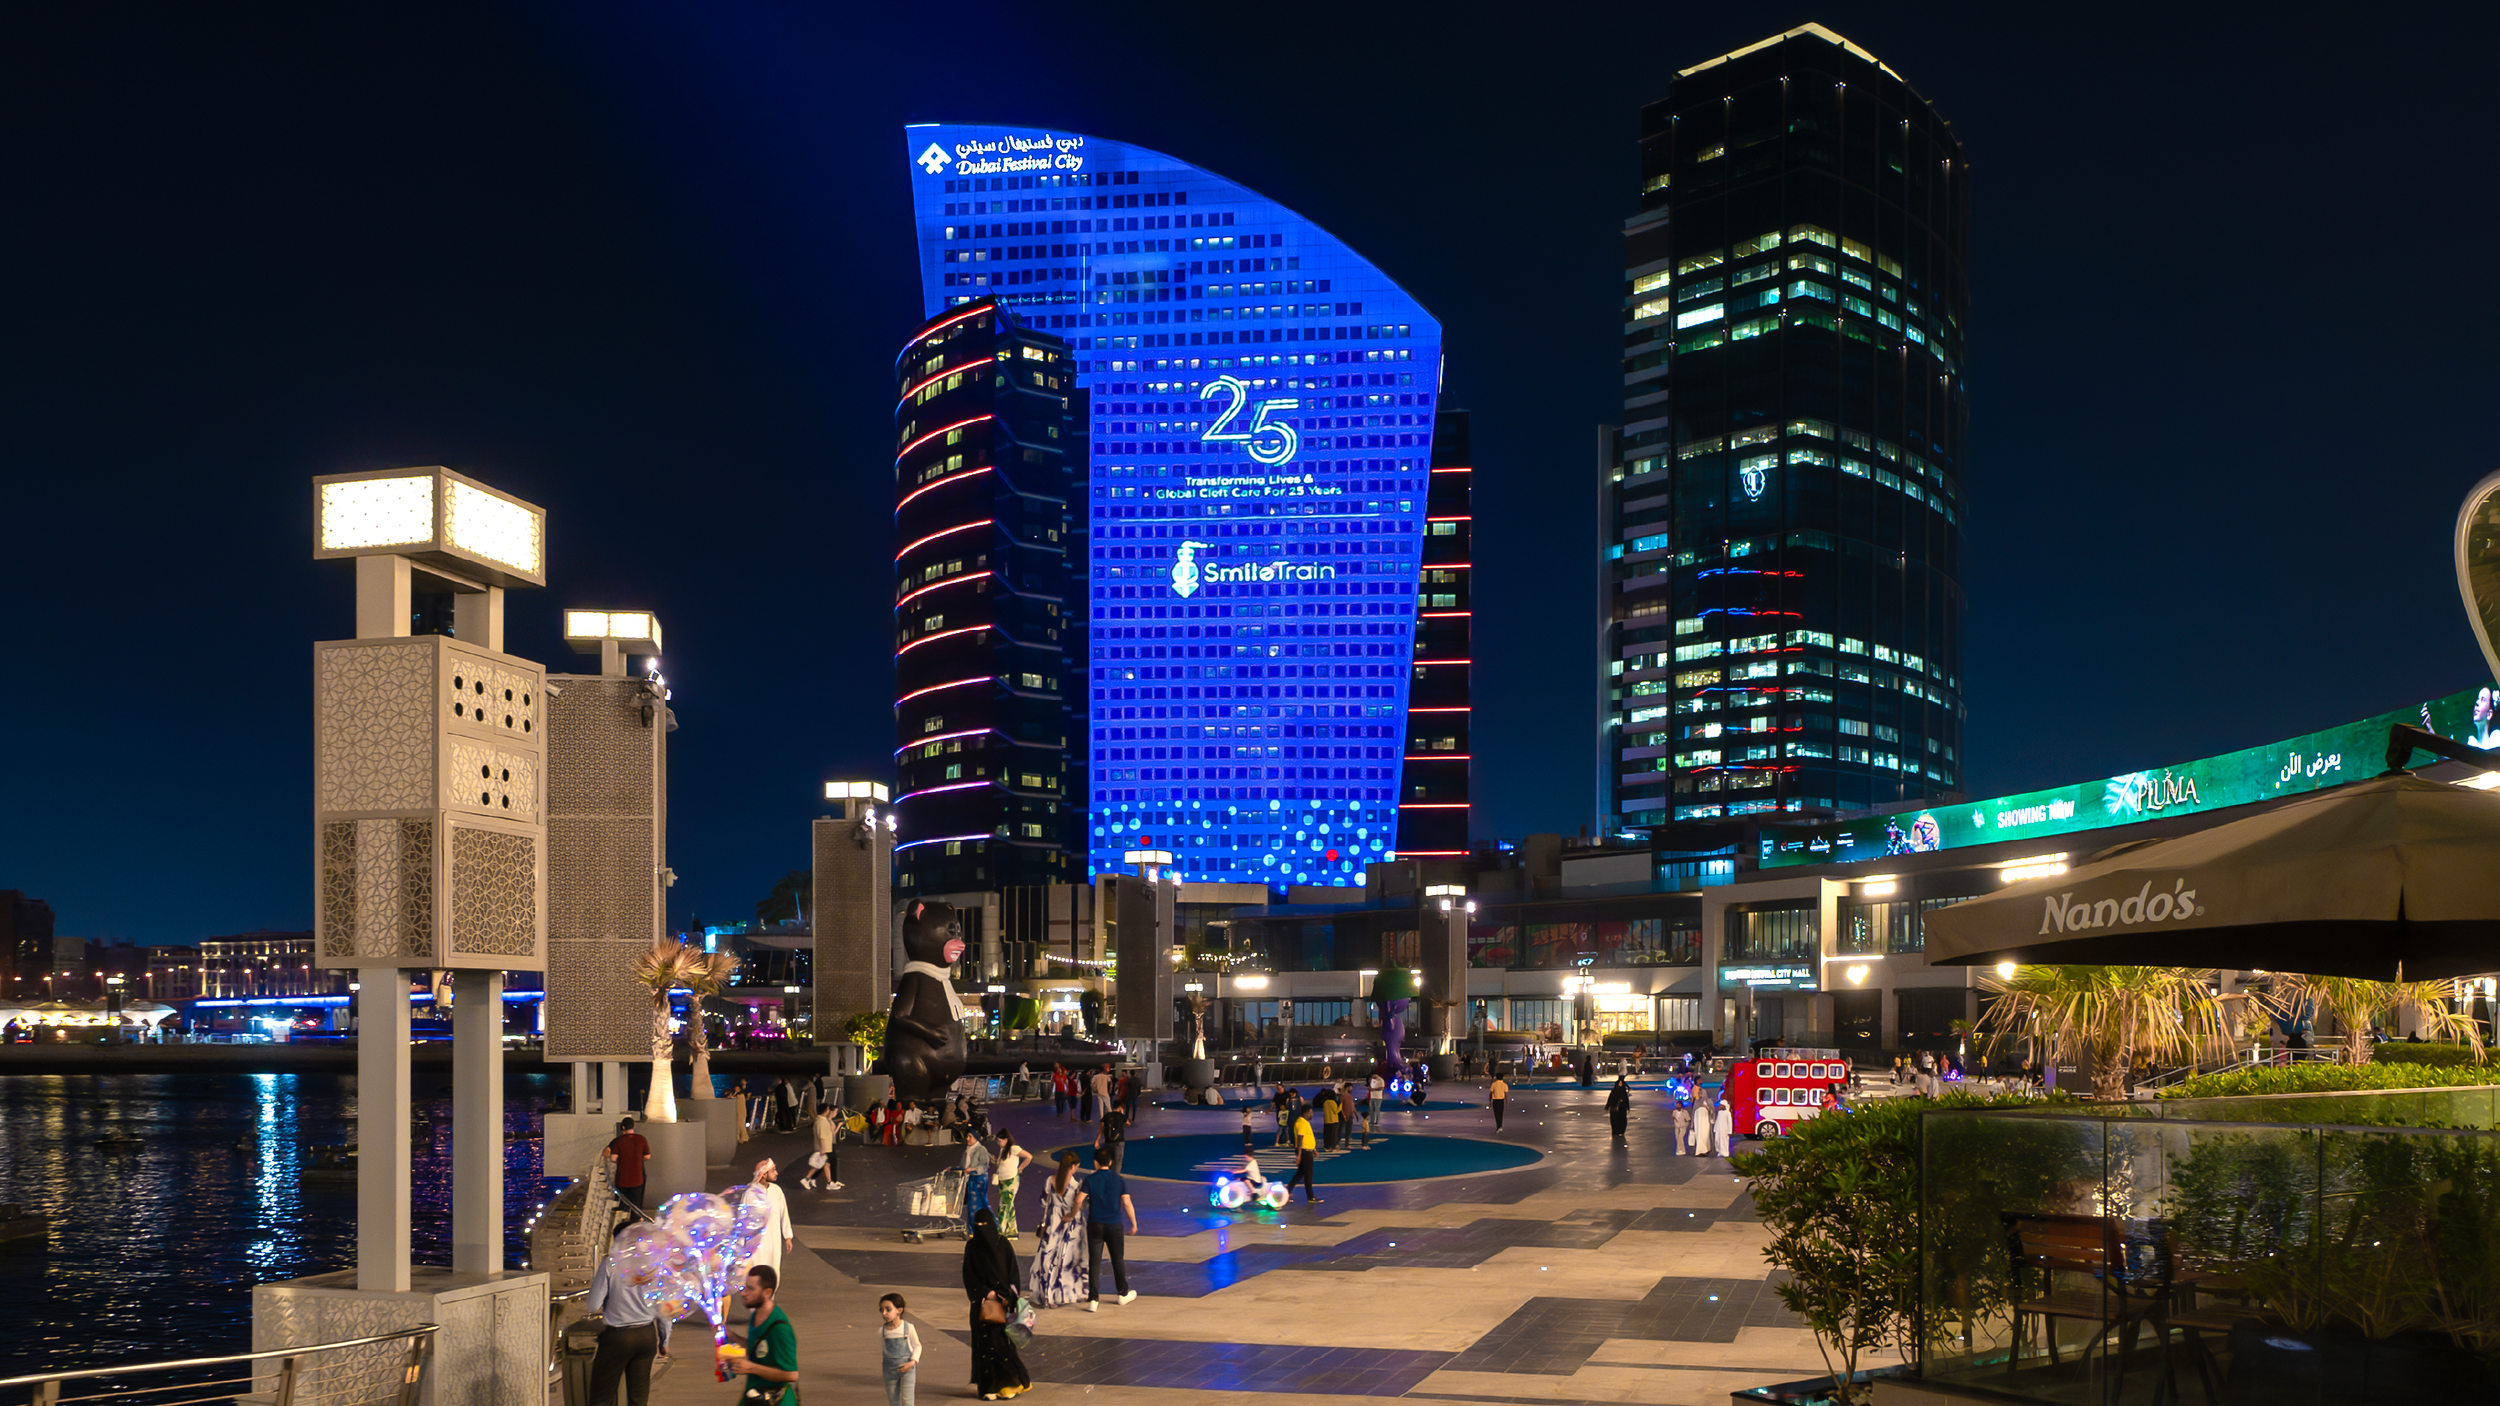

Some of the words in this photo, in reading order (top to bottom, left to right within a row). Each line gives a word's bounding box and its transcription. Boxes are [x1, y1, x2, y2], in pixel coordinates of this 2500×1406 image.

[955, 140, 997, 159] سيتي
[998, 133, 1054, 154] فستيفال
[1056, 136, 1084, 154] دبي
[955, 157, 1001, 175] Dubai
[1001, 154, 1053, 174] Festival
[1054, 153, 1083, 172] City
[1200, 374, 1299, 467] 25
[1184, 476, 1266, 487] Transforming
[1268, 474, 1301, 485] Lives
[1303, 473, 1314, 484] &
[1156, 488, 1196, 499] Global
[1199, 488, 1229, 498] Cleft
[1231, 488, 1261, 498] Care
[1264, 487, 1286, 497] For
[1288, 486, 1304, 496] 25
[1308, 485, 1342, 496] Years
[1203, 561, 1336, 583] SmileTrain
[2280, 751, 2302, 782] الآن
[2306, 751, 2341, 778] يعرض
[2136, 770, 2201, 812] PLUMA
[1997, 804, 2047, 829] SHOWING
[2048, 799, 2075, 821] NOW
[2038, 877, 2196, 936] Nando's
